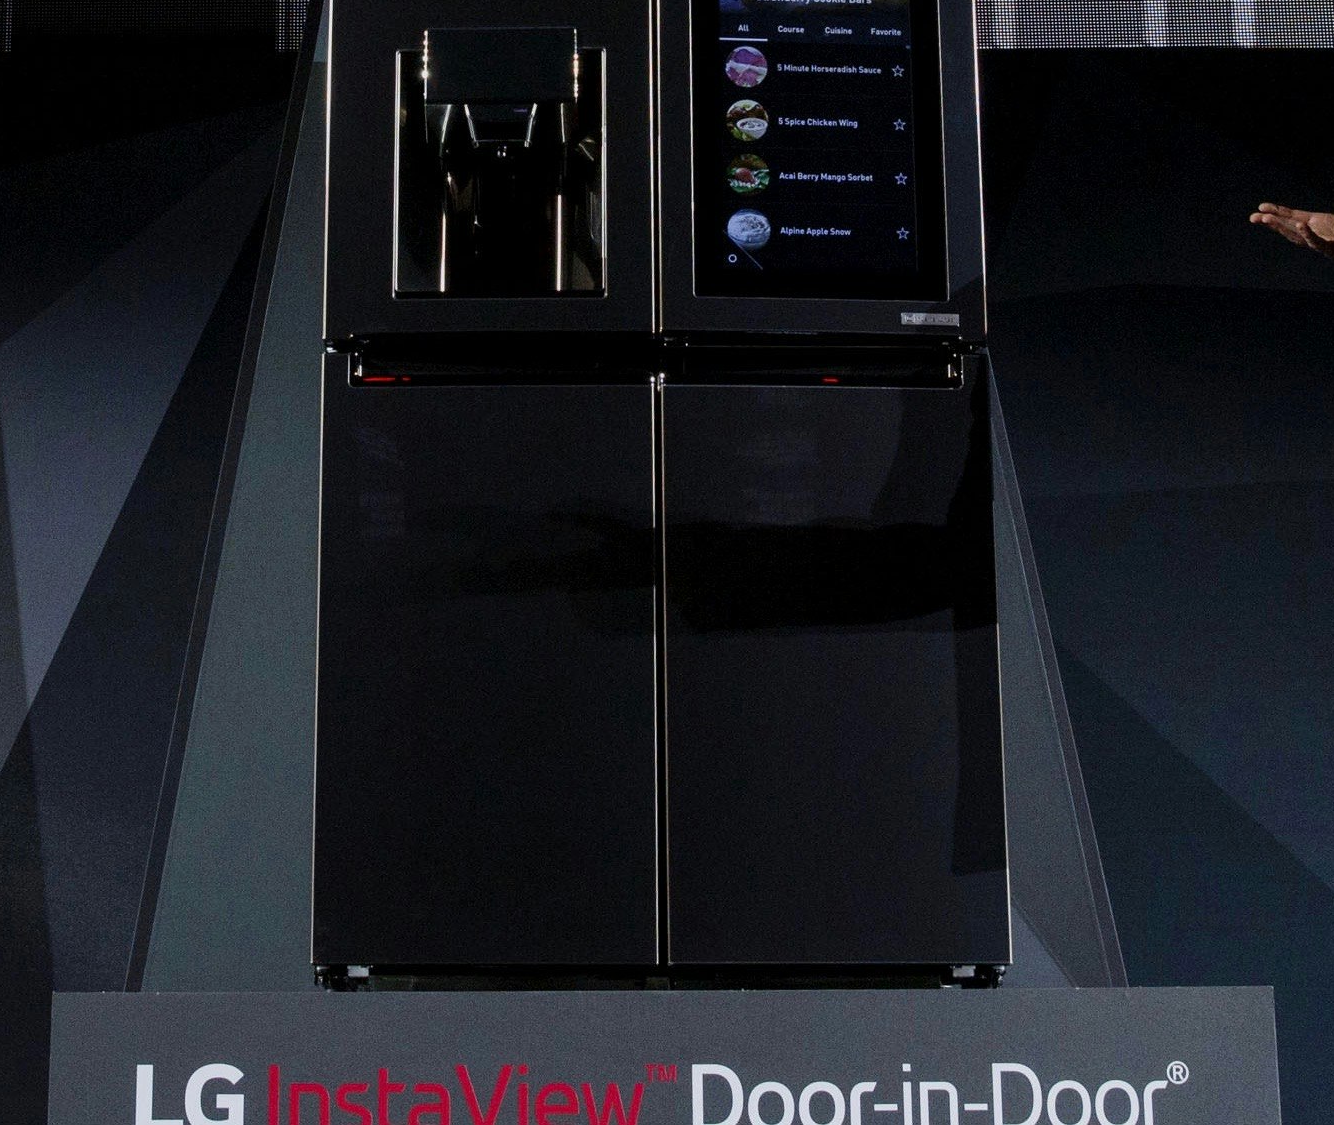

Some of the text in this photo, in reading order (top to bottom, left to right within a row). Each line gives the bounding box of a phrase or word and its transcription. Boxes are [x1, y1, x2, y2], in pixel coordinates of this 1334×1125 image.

[738, 24, 902, 36] All Course Cuisine Favorite
[784, 64, 809, 72] Minute
[811, 64, 857, 73] Horseradish
[859, 66, 882, 74] Sauce
[785, 118, 806, 127] Spice
[807, 118, 837, 126] Chicken
[839, 119, 858, 128] Wing
[798, 172, 819, 181] Berry
[821, 173, 846, 183] Mango
[848, 173, 873, 181] Sorbet
[780, 226, 851, 236] Alpine Apple Snow
[134, 1063, 245, 1125] LG
